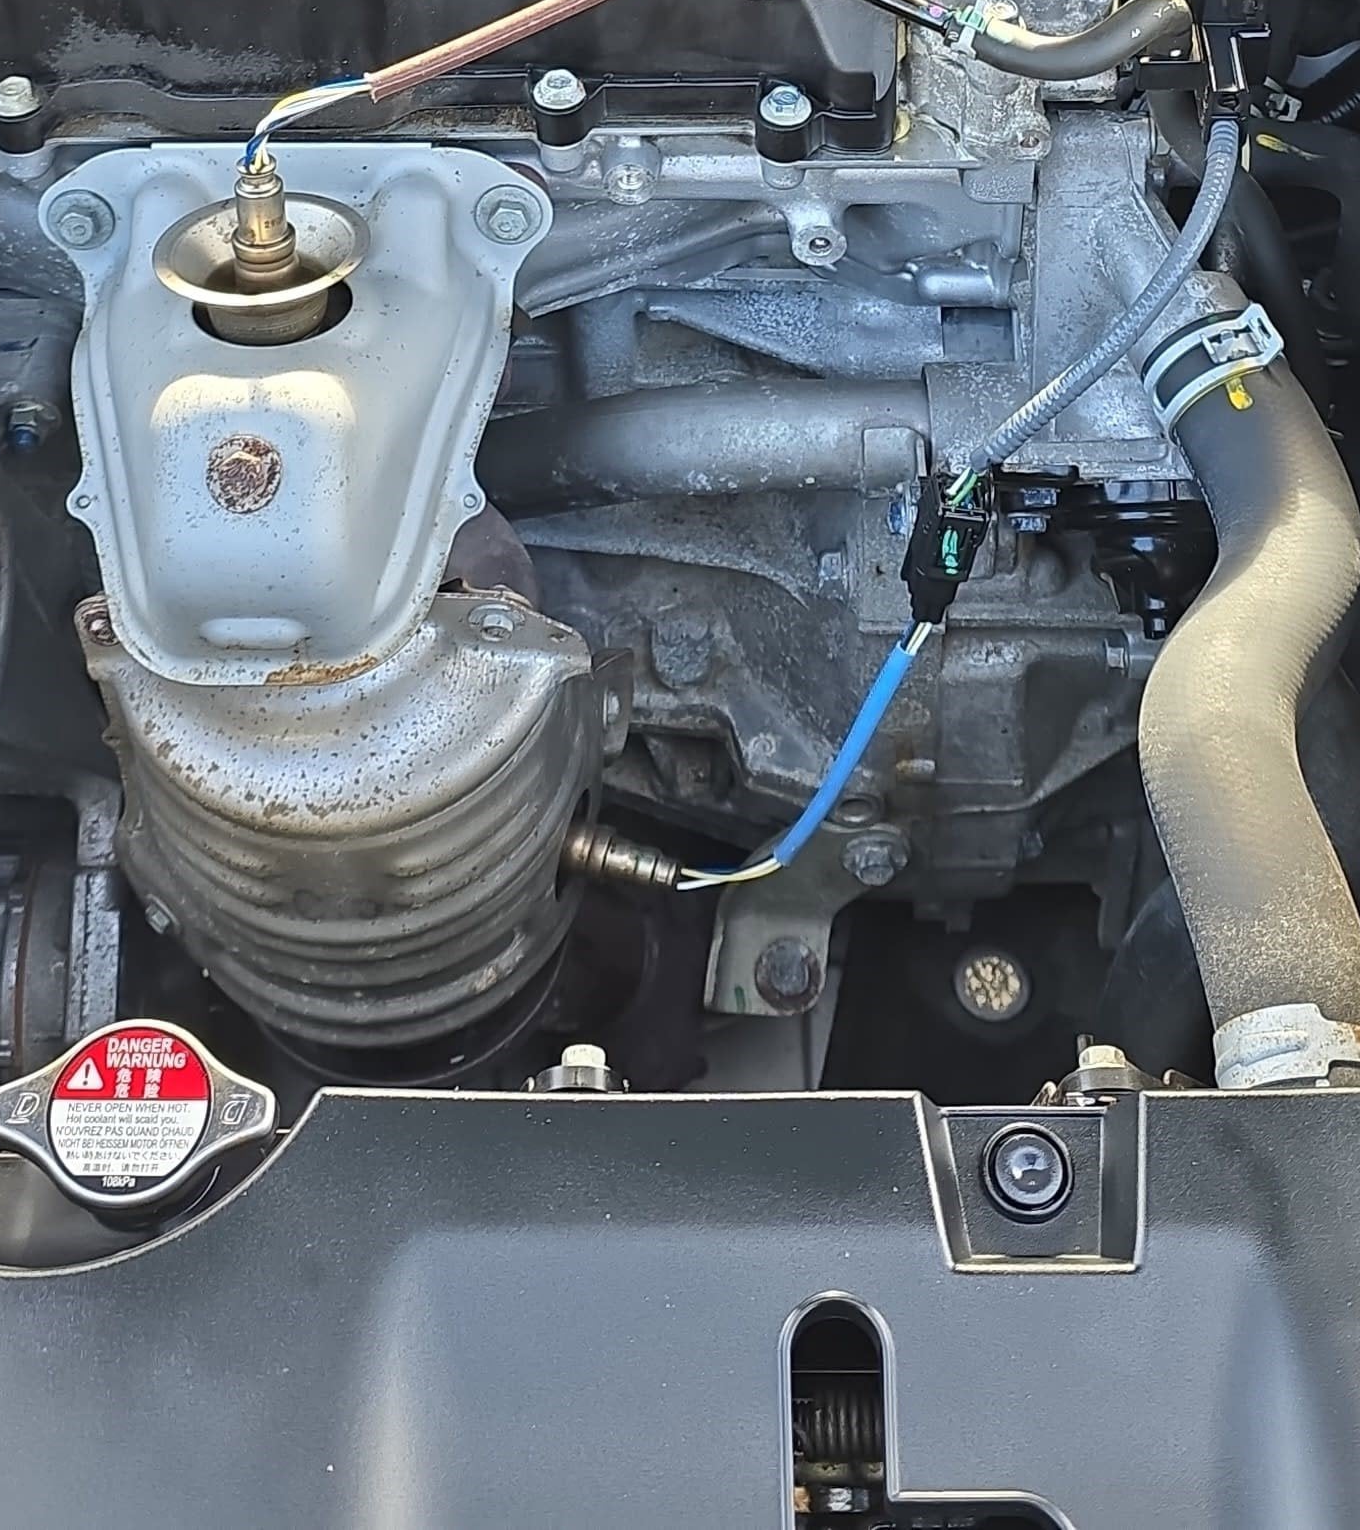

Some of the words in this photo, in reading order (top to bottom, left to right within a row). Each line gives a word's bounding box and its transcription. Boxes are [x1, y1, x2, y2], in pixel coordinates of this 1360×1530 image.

[106, 1038, 173, 1053] DANGER
[106, 1052, 187, 1069] WARNUNG
[68, 1103, 102, 1113] NEVER
[104, 1103, 132, 1113] OPEN
[135, 1103, 165, 1113] WHEN
[168, 1103, 191, 1113] HOT.
[66, 1114, 82, 1123] Hot
[84, 1114, 117, 1123] coolant
[118, 1114, 133, 1123] will
[56, 1126, 102, 1136] N'OUVREZ
[105, 1126, 123, 1136] PAS
[126, 1126, 159, 1137] QUAND
[58, 1139, 81, 1149] NICHT
[82, 1139, 95, 1149] BEI
[96, 1139, 129, 1149] HEISSEM
[131, 1139, 158, 1149] MOTOR
